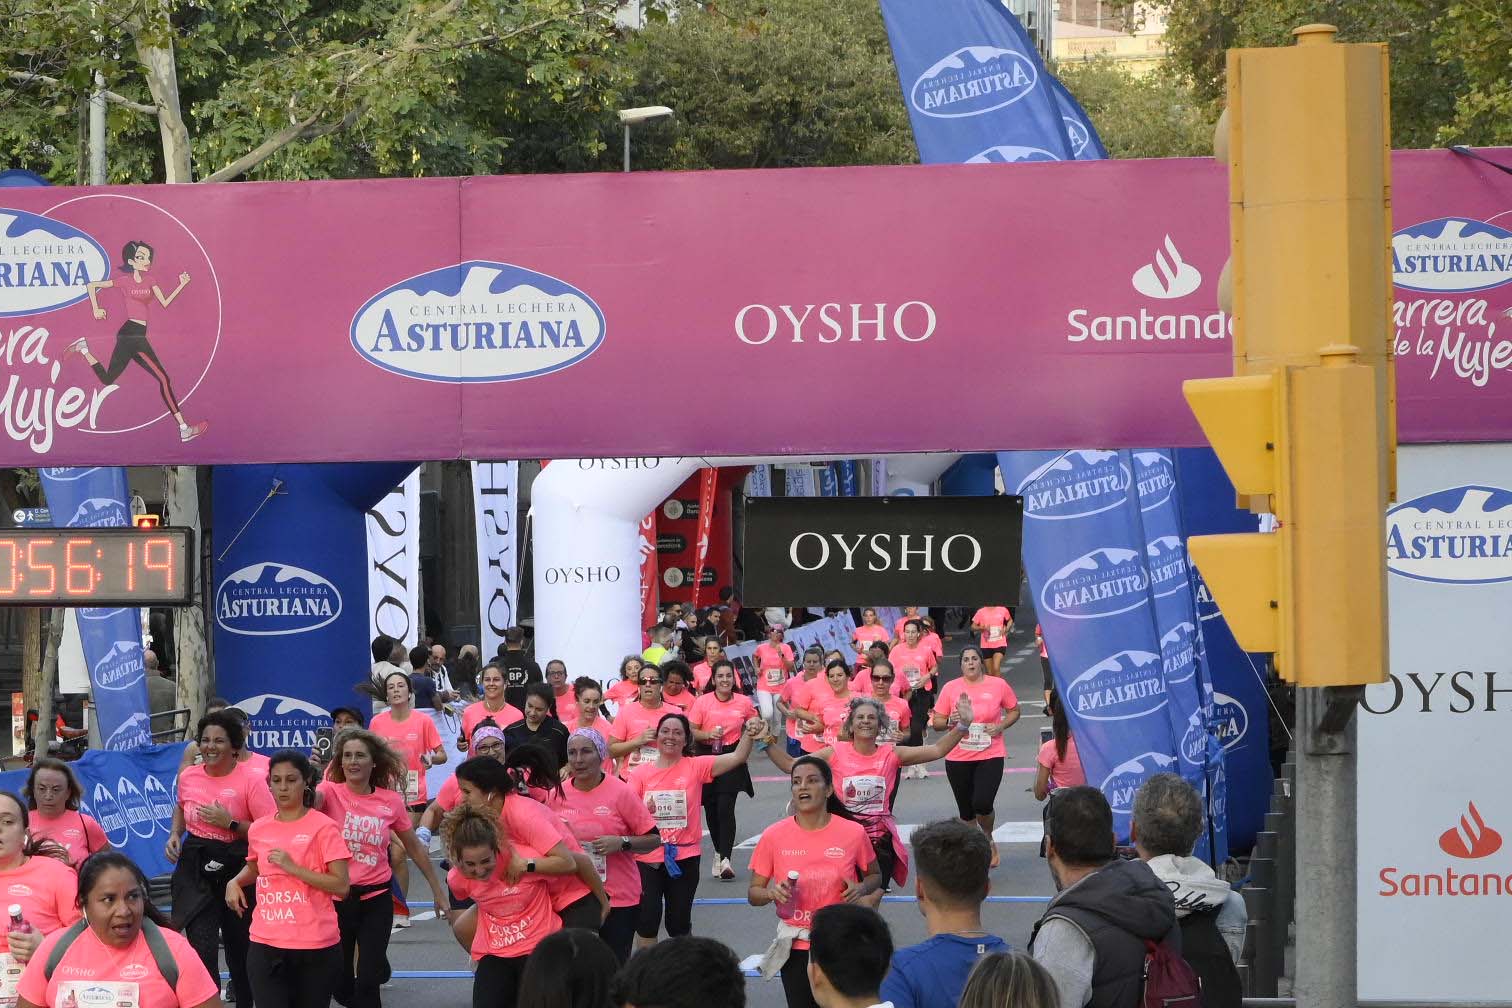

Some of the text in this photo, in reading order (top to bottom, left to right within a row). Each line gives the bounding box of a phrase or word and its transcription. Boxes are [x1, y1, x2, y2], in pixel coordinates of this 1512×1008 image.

[12, 245, 85, 256] LECHERA
[1407, 243, 1457, 251] CENTRAL
[409, 302, 577, 318] CENTRAL LECHERA
[370, 307, 587, 353] ASTURIANA
[734, 300, 938, 345] OYSHO
[1416, 328, 1434, 355] la
[1413, 520, 1481, 531] CENTRAL
[789, 532, 983, 574] OYSHO
[545, 565, 621, 585] OYSHO
[232, 587, 328, 596] CENTRAL LECHERA
[219, 592, 333, 620] ASTURIANA
